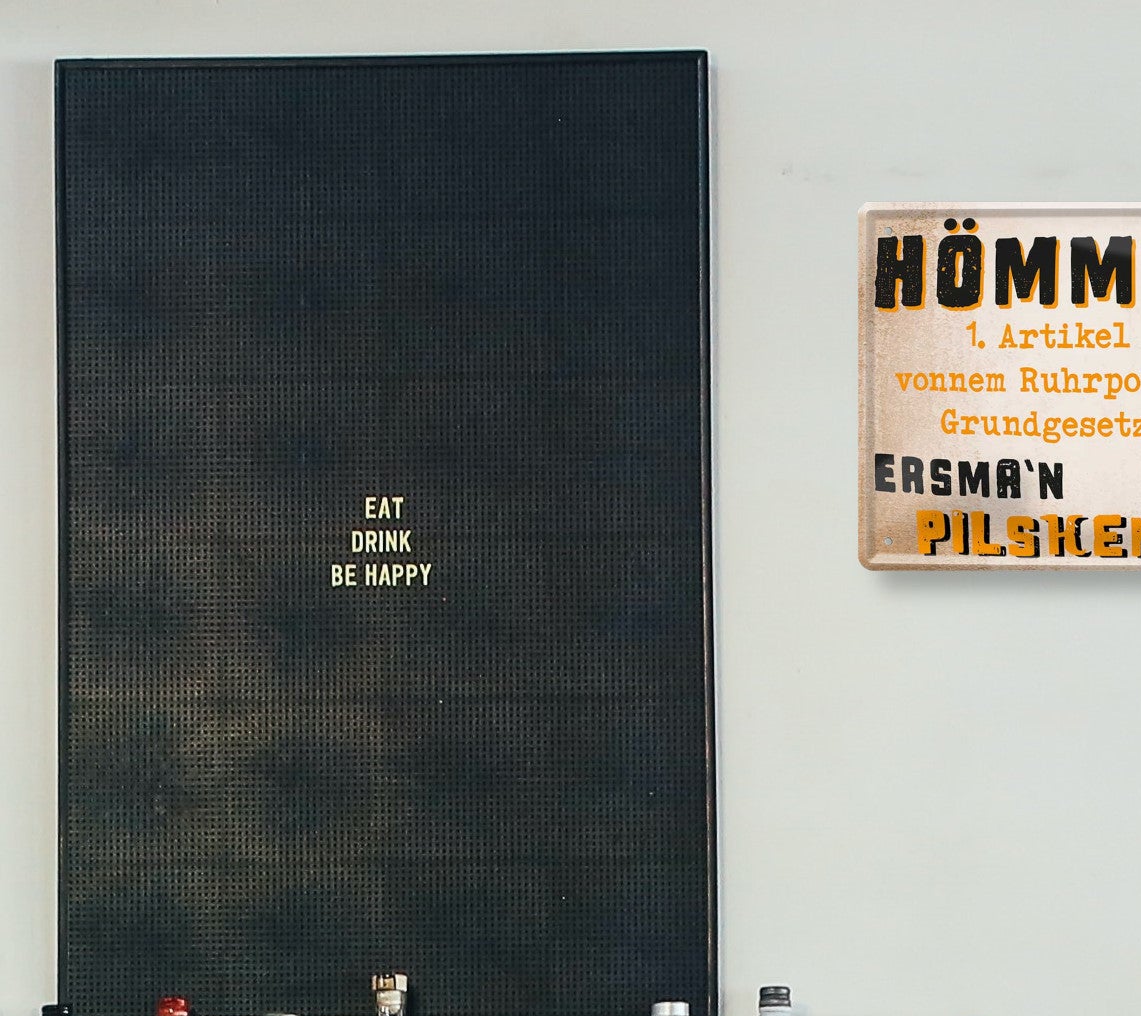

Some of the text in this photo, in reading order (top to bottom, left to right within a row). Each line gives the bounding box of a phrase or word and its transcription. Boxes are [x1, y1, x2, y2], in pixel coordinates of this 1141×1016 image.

[965, 322, 1130, 349] 1. Artikel
[895, 373, 1006, 394] vonnem
[365, 496, 404, 519] EAT
[351, 529, 412, 553] DRINK
[331, 563, 432, 587] BE HAPPY
